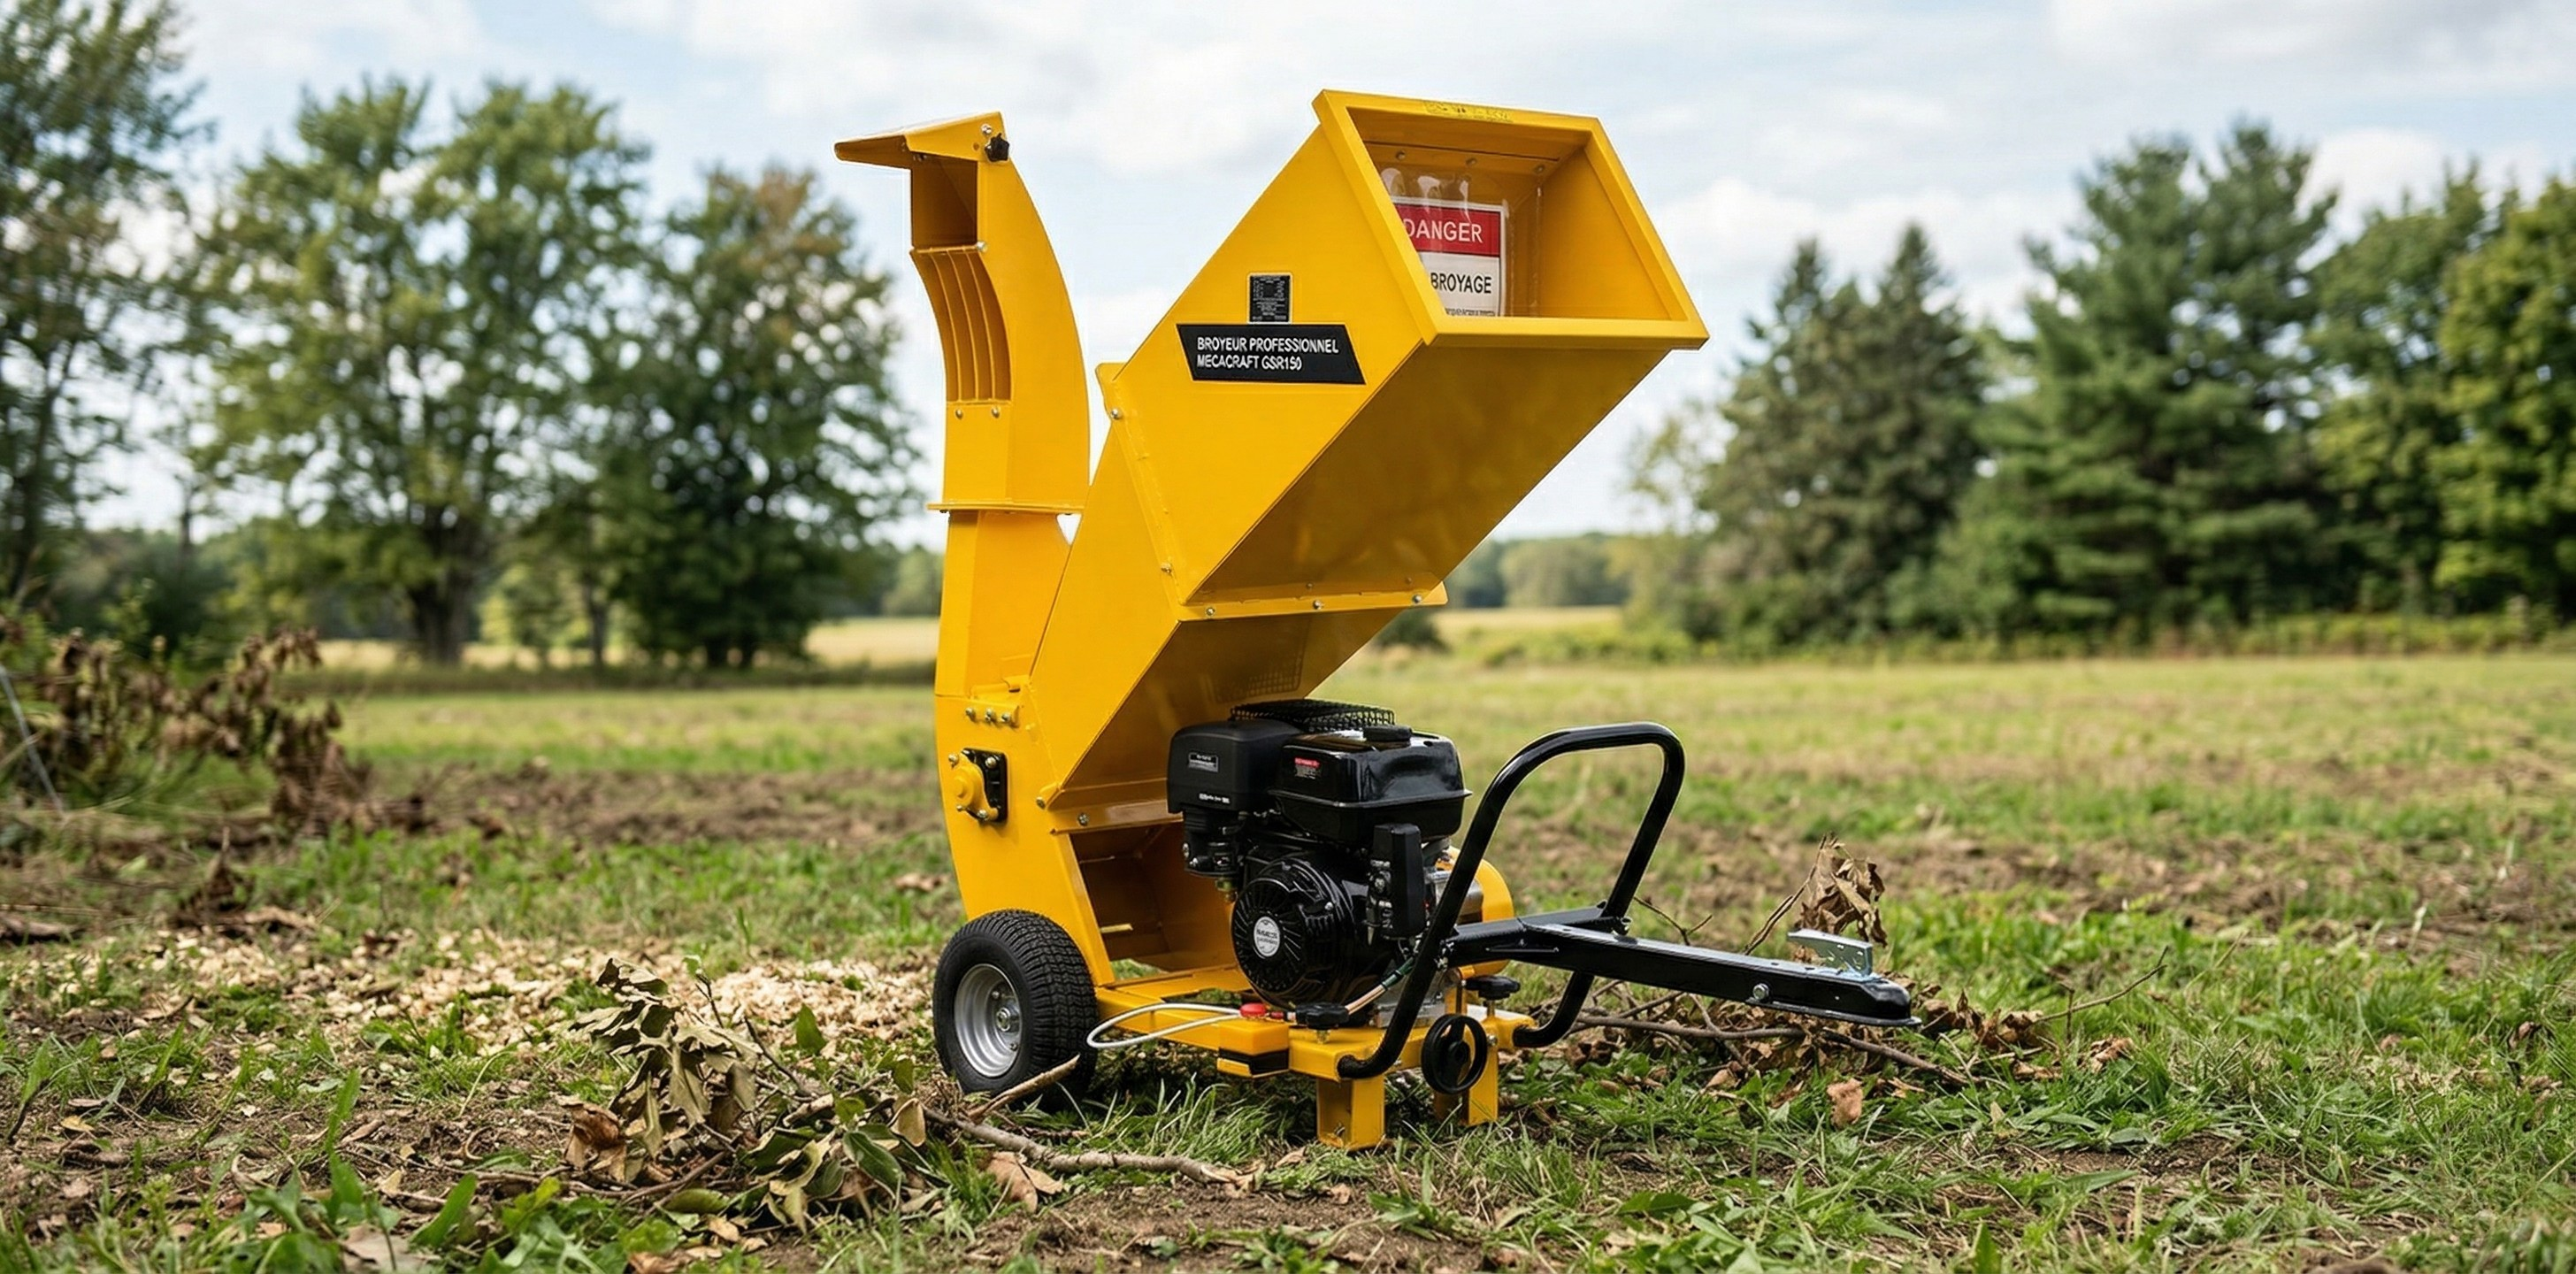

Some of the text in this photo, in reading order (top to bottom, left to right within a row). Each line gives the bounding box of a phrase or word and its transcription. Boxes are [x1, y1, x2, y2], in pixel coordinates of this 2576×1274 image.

[1403, 219, 1483, 243] DANGER
[1430, 272, 1491, 294] BROYAGE
[1197, 337, 1338, 353] BROYEUR PROFESSIONNEL
[1197, 355, 1301, 370] MECACRAFT GSR150
